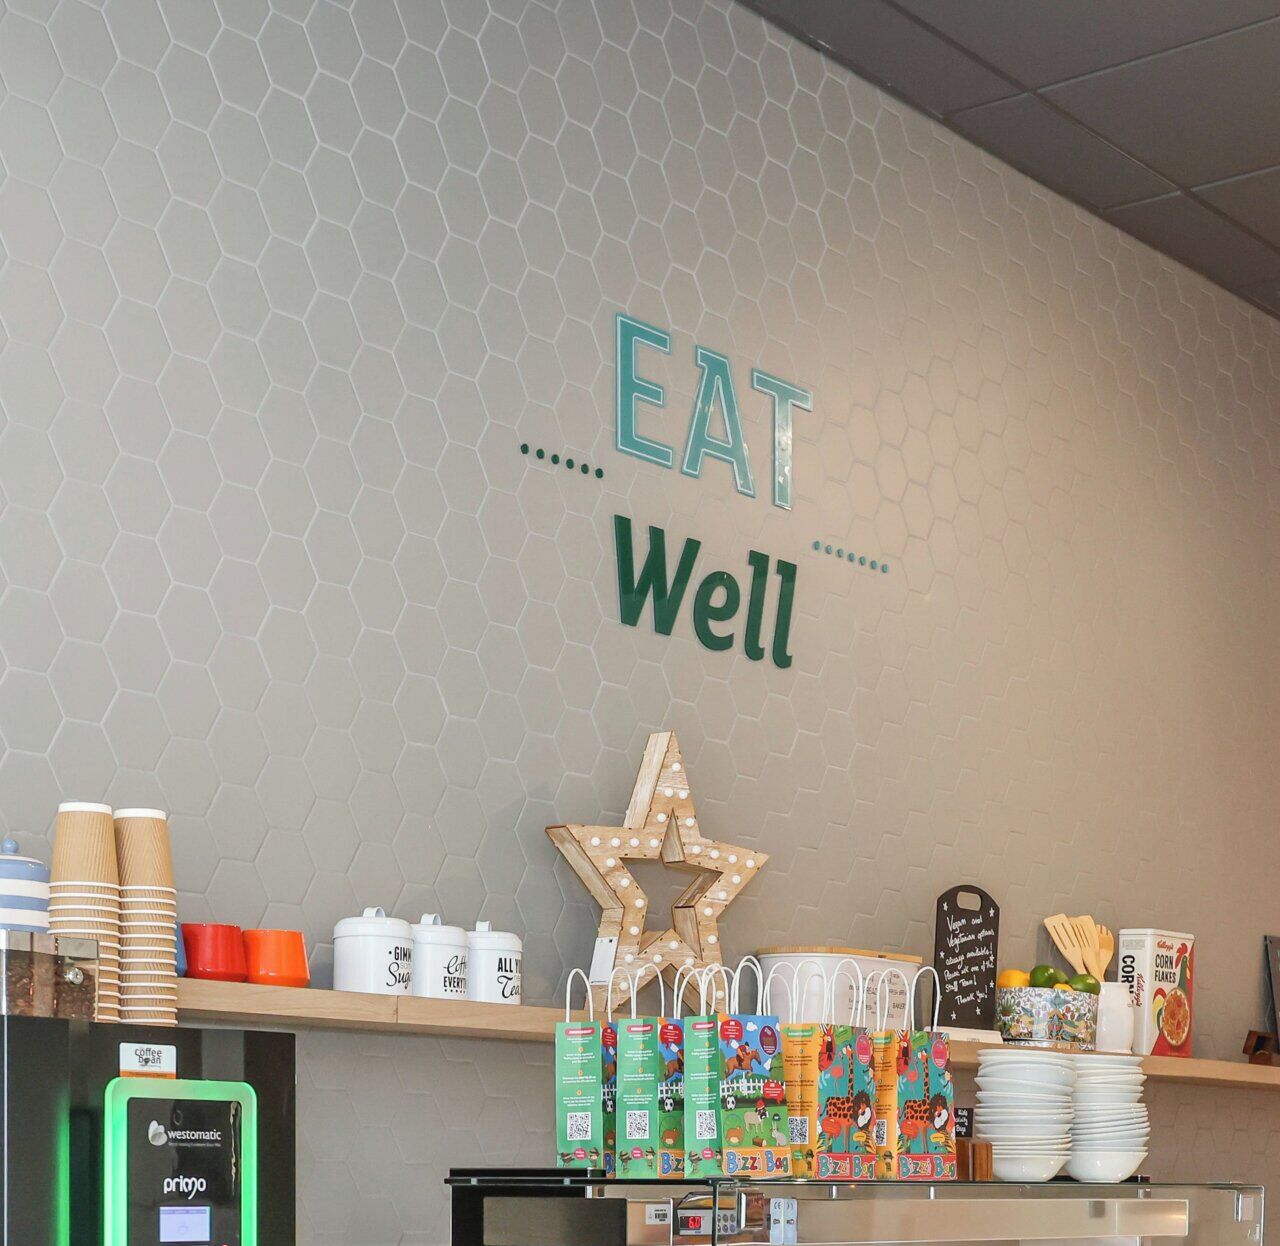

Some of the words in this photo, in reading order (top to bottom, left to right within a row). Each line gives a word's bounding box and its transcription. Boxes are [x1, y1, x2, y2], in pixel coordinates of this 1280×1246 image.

[615, 312, 814, 511] EAT
[613, 514, 798, 669] Well
[947, 915, 967, 933] Vegan
[971, 915, 983, 925] and
[946, 933, 976, 953] Vegetarian
[977, 928, 995, 941] options
[394, 946, 412, 962] GIMM
[945, 954, 965, 969] always
[1155, 953, 1174, 969] CORN
[497, 957, 513, 973] ALL
[386, 961, 412, 990] Sug
[943, 969, 960, 981] Please
[1154, 970, 1177, 984] FLAKES
[945, 980, 959, 993] Staff
[954, 993, 976, 1006] Thank
[134, 1047, 163, 1057] coffee
[167, 1128, 222, 1141] westomatic
[726, 1150, 762, 1174] Bizzi
[765, 1149, 790, 1174] Bag
[819, 1154, 850, 1177] Bizzi
[853, 1154, 876, 1179] Bag
[898, 1155, 931, 1178] Bizzi
[933, 1155, 957, 1179] Bag
[163, 1174, 207, 1200] primo
